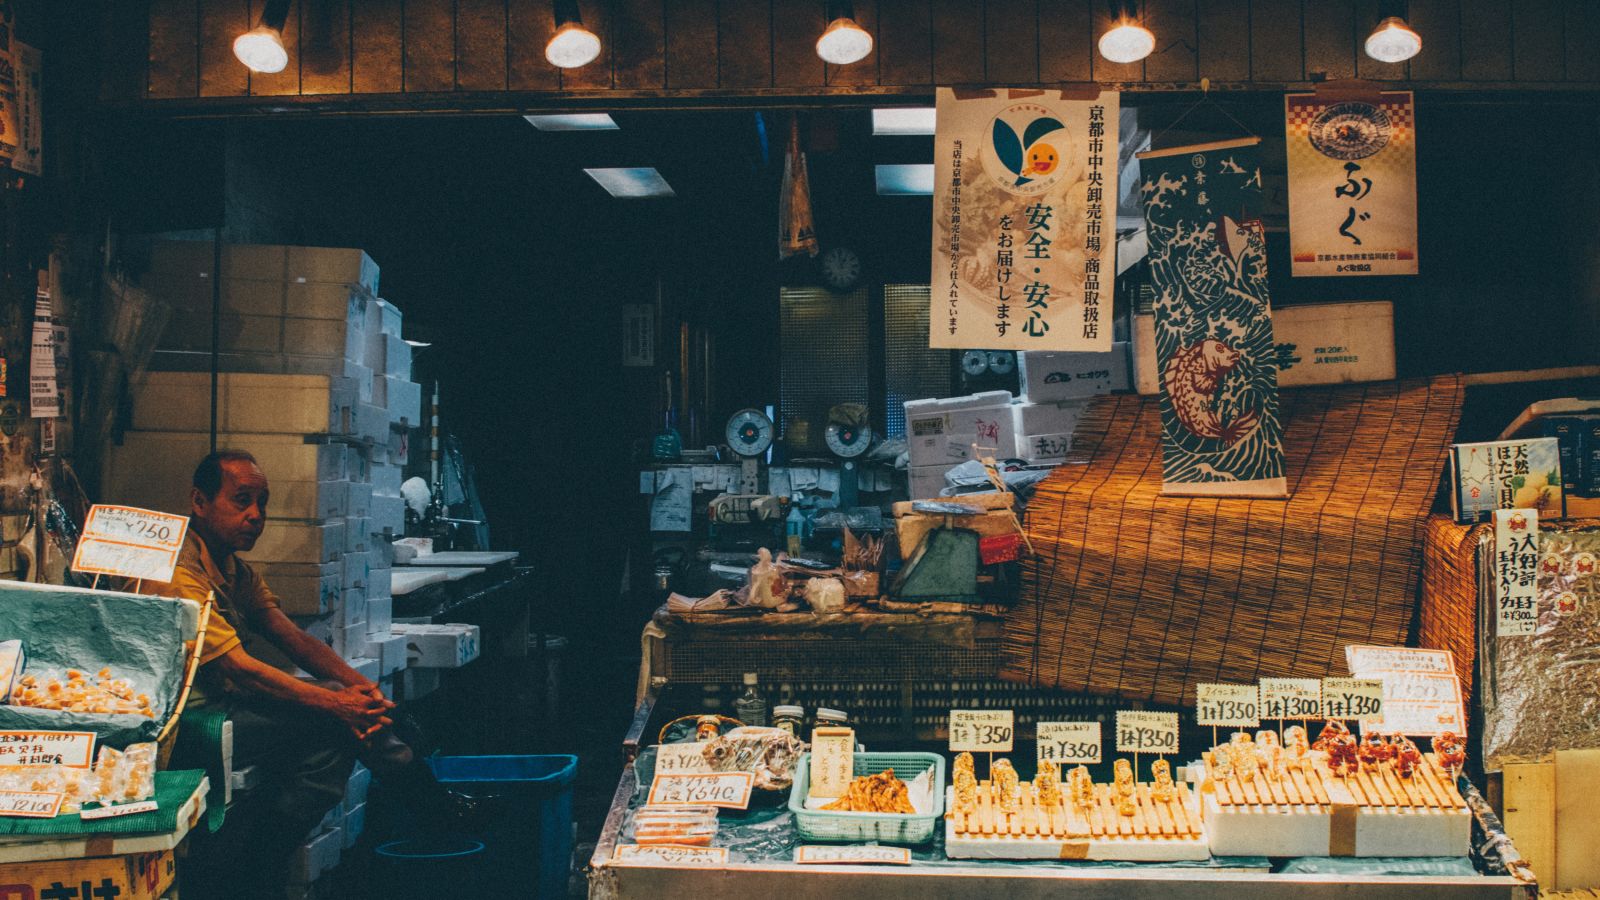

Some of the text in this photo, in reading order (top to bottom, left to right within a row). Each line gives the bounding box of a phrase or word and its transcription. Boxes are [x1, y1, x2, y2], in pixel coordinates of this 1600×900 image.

[1082, 104, 1105, 339] 京都市中央卸売市場 商品取扱店
[1336, 161, 1373, 245] ふぐ
[995, 215, 1014, 337] をお届けします
[1022, 203, 1052, 338] 安全・安心
[1512, 444, 1530, 475] 天然
[1519, 533, 1537, 586] 大好評
